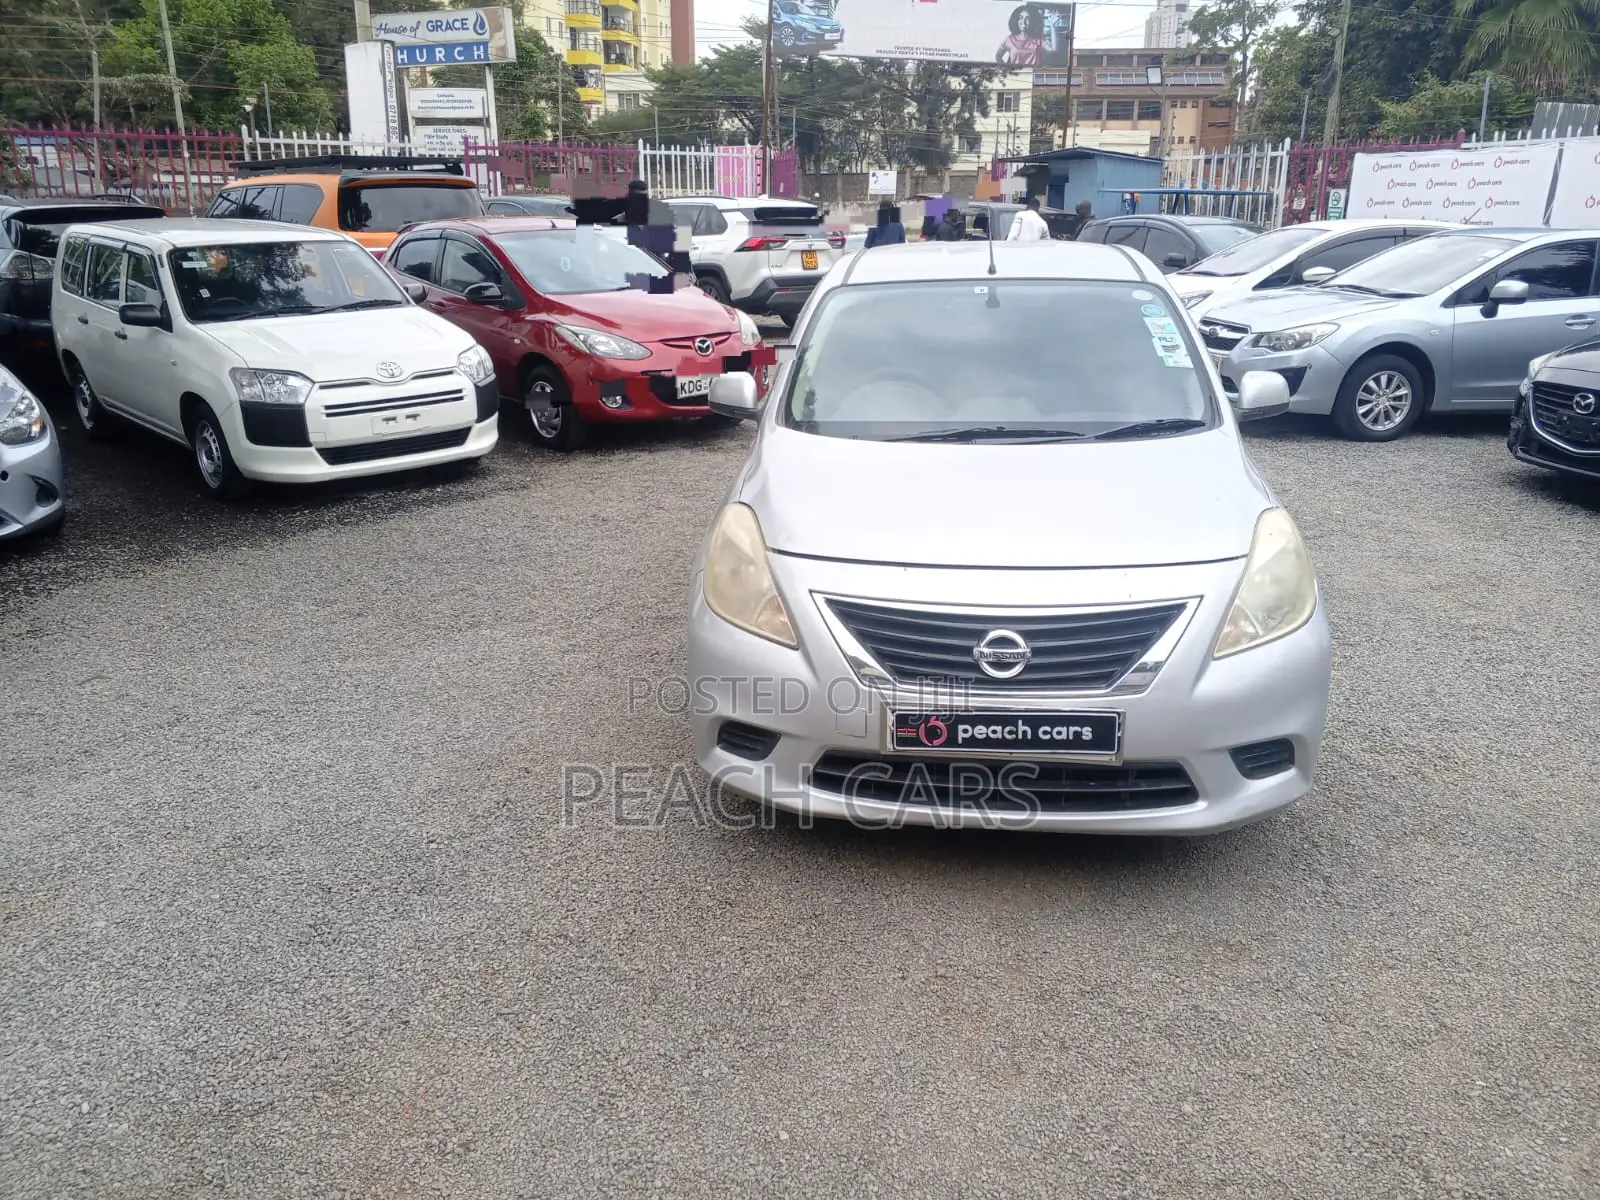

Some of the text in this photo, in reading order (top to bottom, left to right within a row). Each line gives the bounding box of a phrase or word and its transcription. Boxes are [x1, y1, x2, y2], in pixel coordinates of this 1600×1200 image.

[376, 18, 470, 38] House of GRACE
[397, 44, 484, 64] HURCH
[680, 380, 702, 395] KDG
[980, 652, 1024, 660] NISSAN
[957, 720, 1093, 744] peach cars
